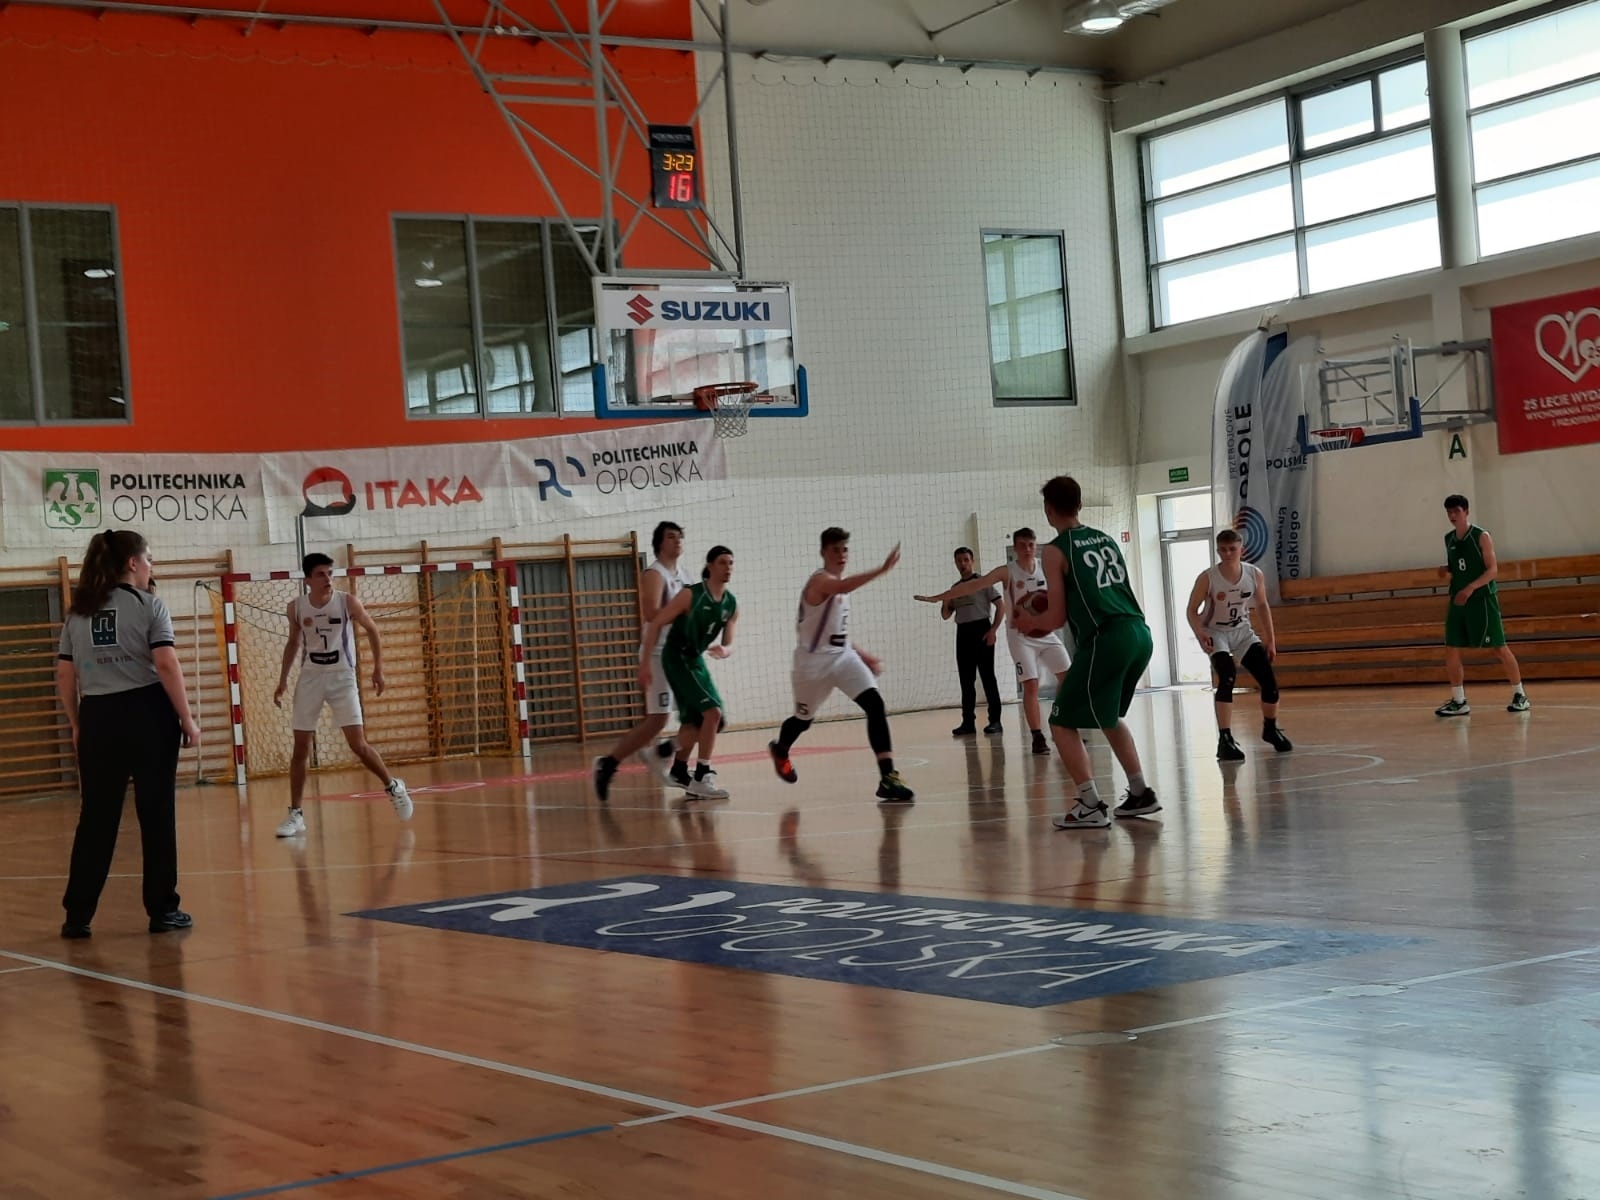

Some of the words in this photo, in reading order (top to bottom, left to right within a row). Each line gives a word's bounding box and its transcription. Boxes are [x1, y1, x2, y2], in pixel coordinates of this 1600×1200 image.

[663, 153, 693, 171] 3:23
[670, 174, 691, 202] 16
[661, 301, 770, 321] SUZUKI
[593, 441, 698, 467] POLITECHNIKA
[1235, 403, 1252, 499] OPOLE
[1449, 433, 1466, 460] A
[110, 473, 246, 490] POLITECHNIKA
[596, 459, 703, 494] OPOLSKA
[366, 475, 483, 510] ITAKA
[112, 494, 248, 522] OPOLSKA
[1083, 546, 1126, 589] 23
[1458, 557, 1466, 571] 8
[736, 897, 1290, 958] POLITECHNIKA
[595, 914, 1157, 990] OPOLSKA
